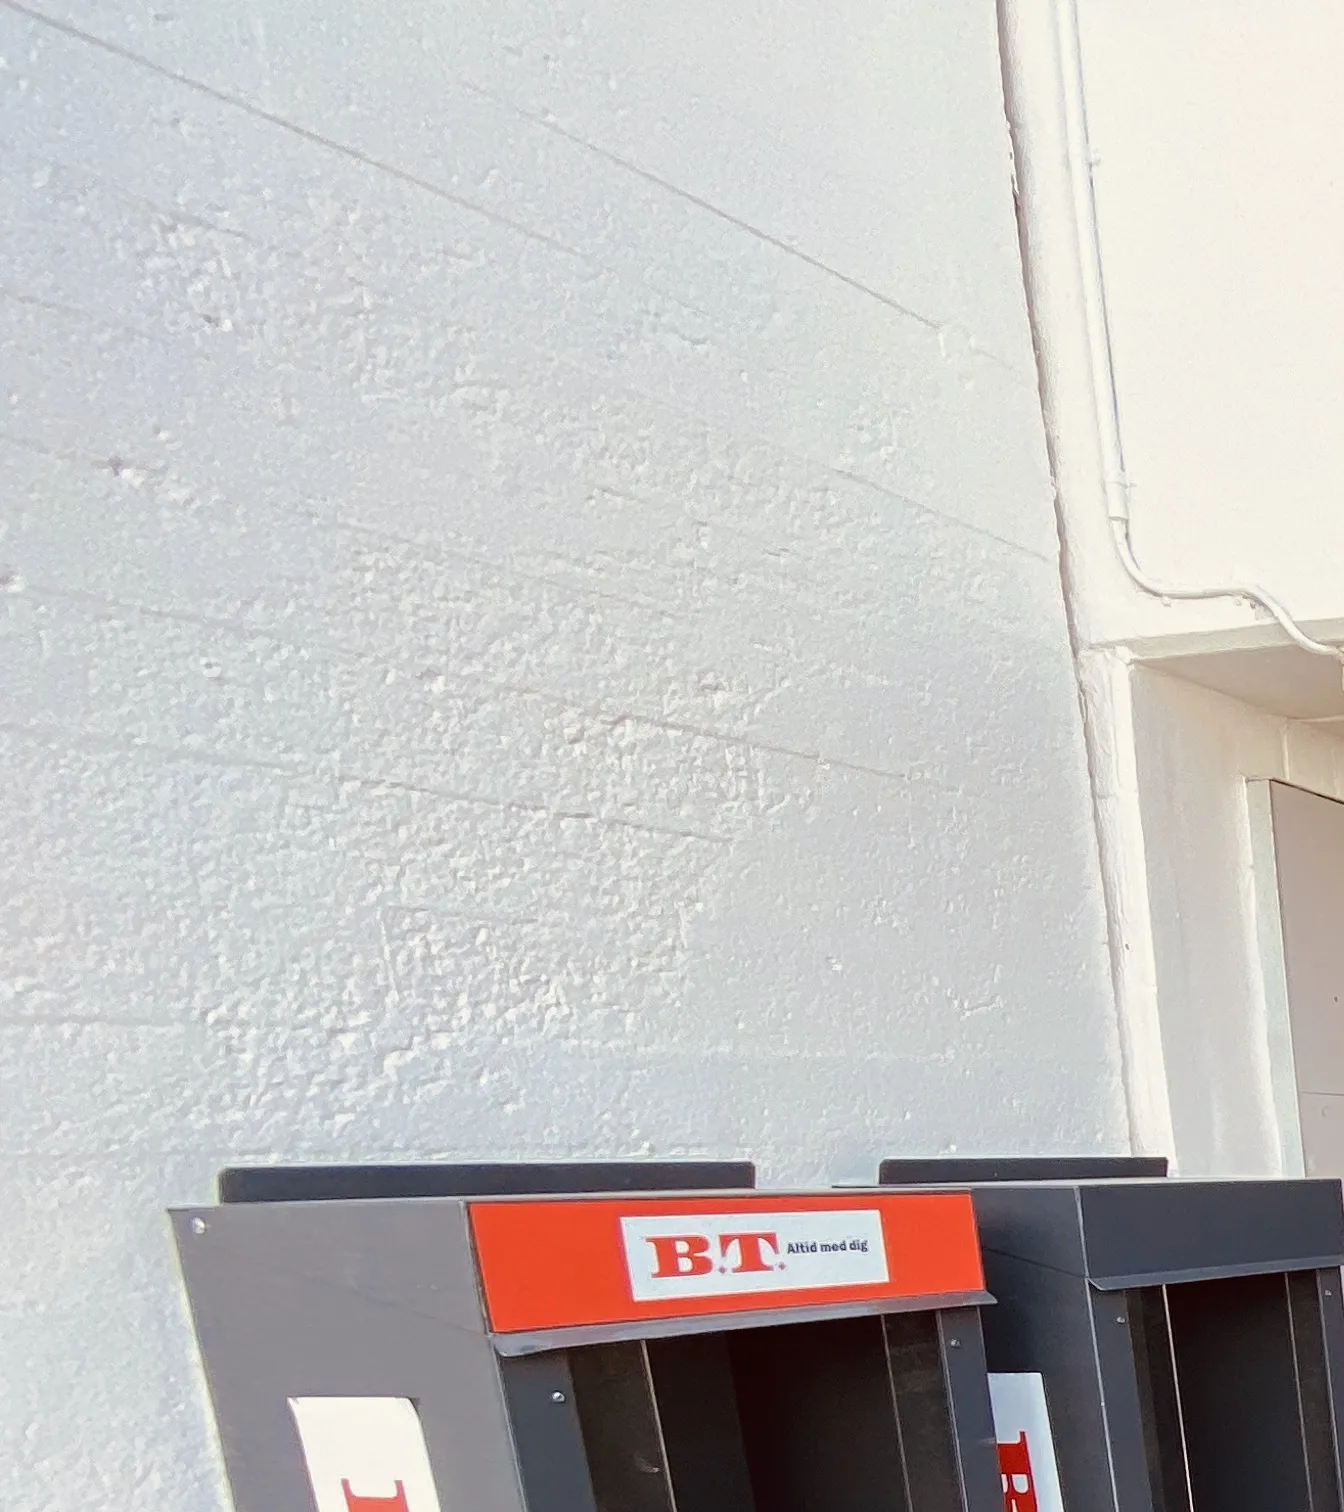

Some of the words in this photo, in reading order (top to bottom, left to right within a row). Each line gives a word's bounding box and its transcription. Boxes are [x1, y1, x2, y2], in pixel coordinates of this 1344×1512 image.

[645, 1231, 786, 1278] B.T.
[787, 1239, 818, 1254] Altid
[820, 1239, 847, 1253] med
[849, 1238, 868, 1254] dig
